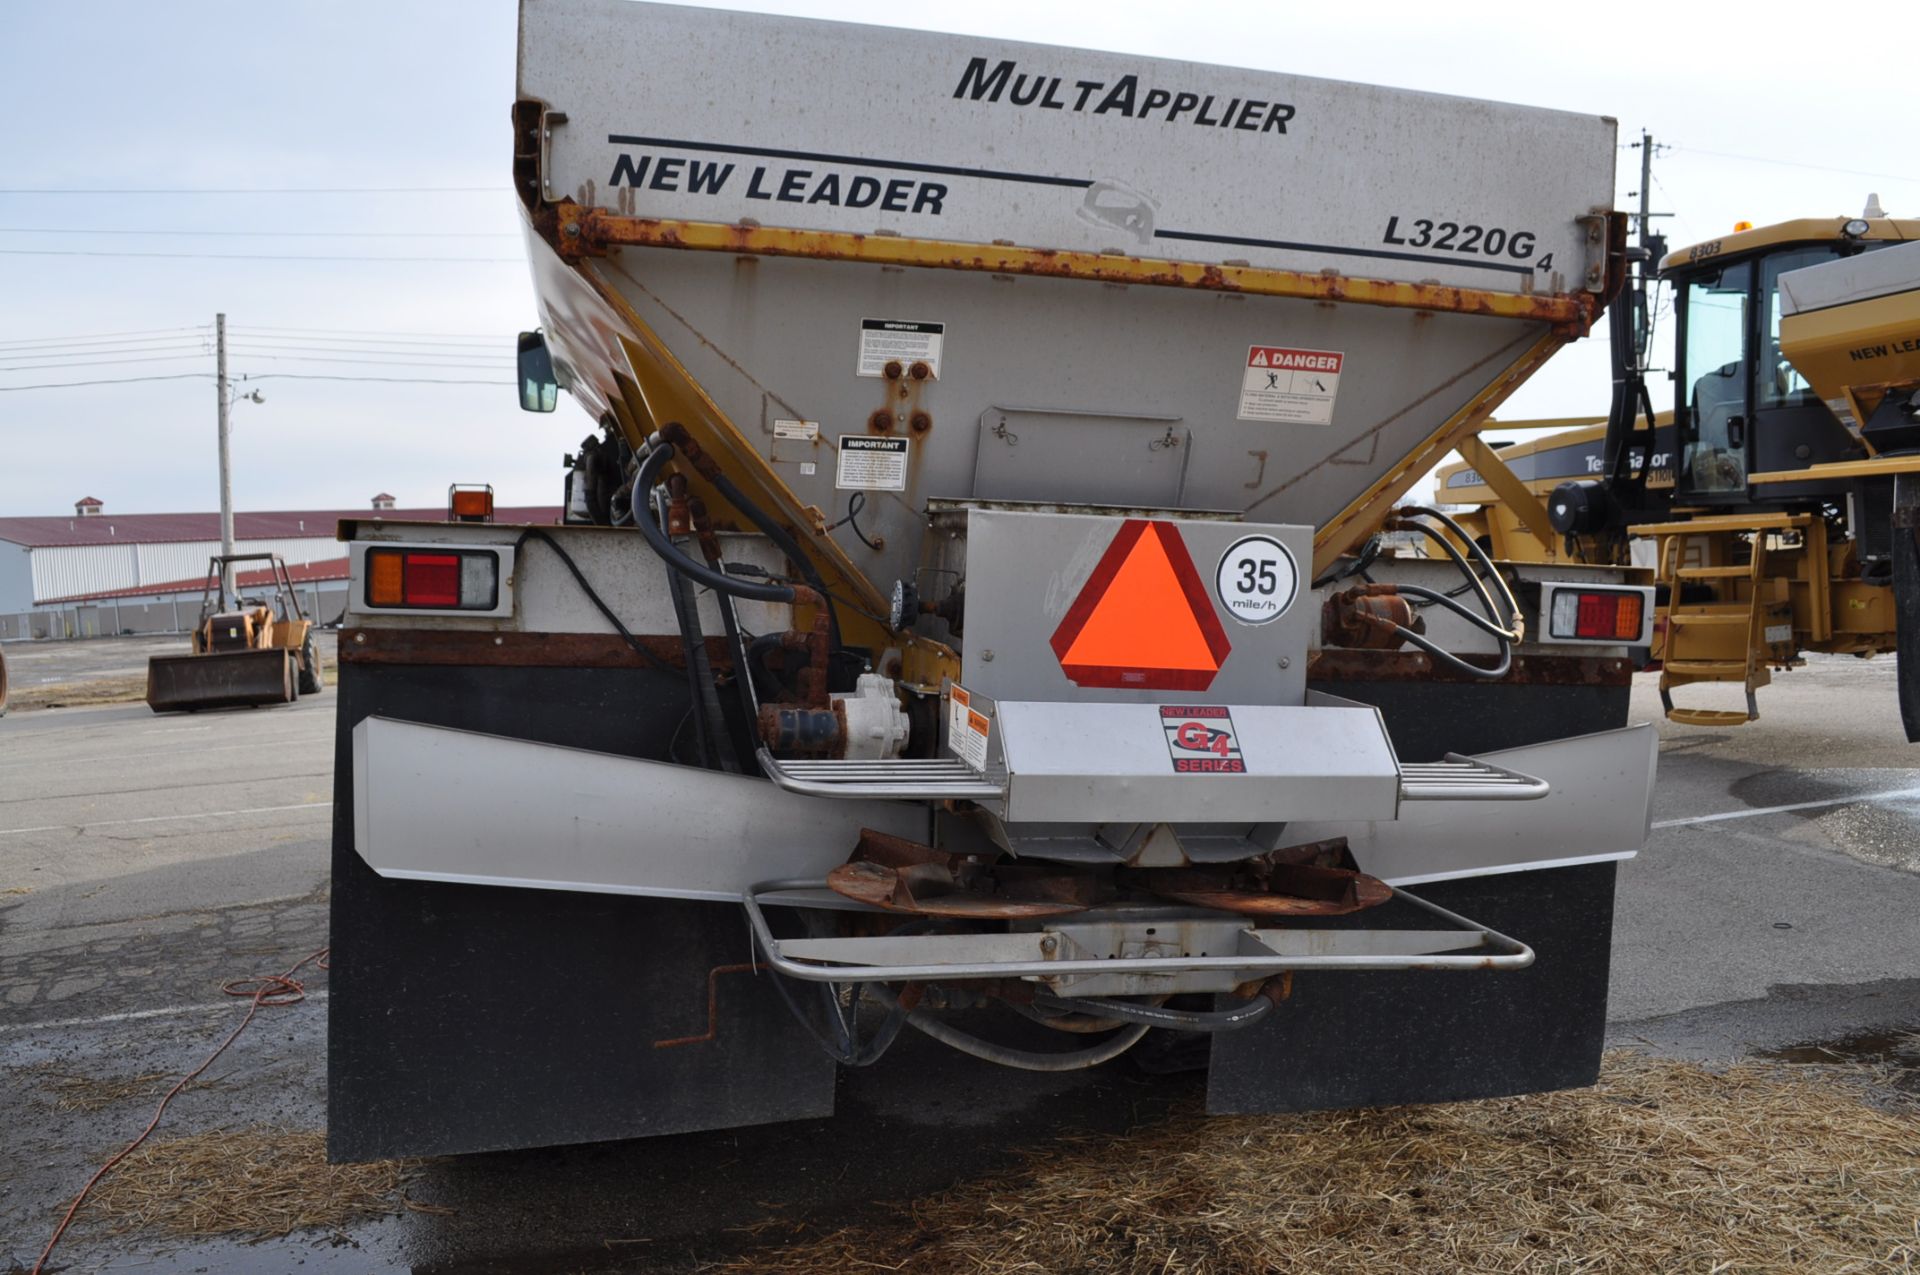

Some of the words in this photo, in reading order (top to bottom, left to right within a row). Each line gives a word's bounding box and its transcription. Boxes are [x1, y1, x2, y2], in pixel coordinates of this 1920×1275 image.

[608, 154, 735, 195] NEW
[746, 167, 949, 215] LEADER
[884, 323, 919, 331] IMPORTANT
[1849, 345, 1888, 361] NEW
[1272, 352, 1338, 370] DANGER
[848, 439, 900, 450] IMPORTANT
[1237, 558, 1277, 596] 35
[1232, 599, 1277, 611] mile/h
[1162, 706, 1185, 717] NEW
[1186, 707, 1227, 718] LEADER
[1177, 758, 1243, 772] SERIES
